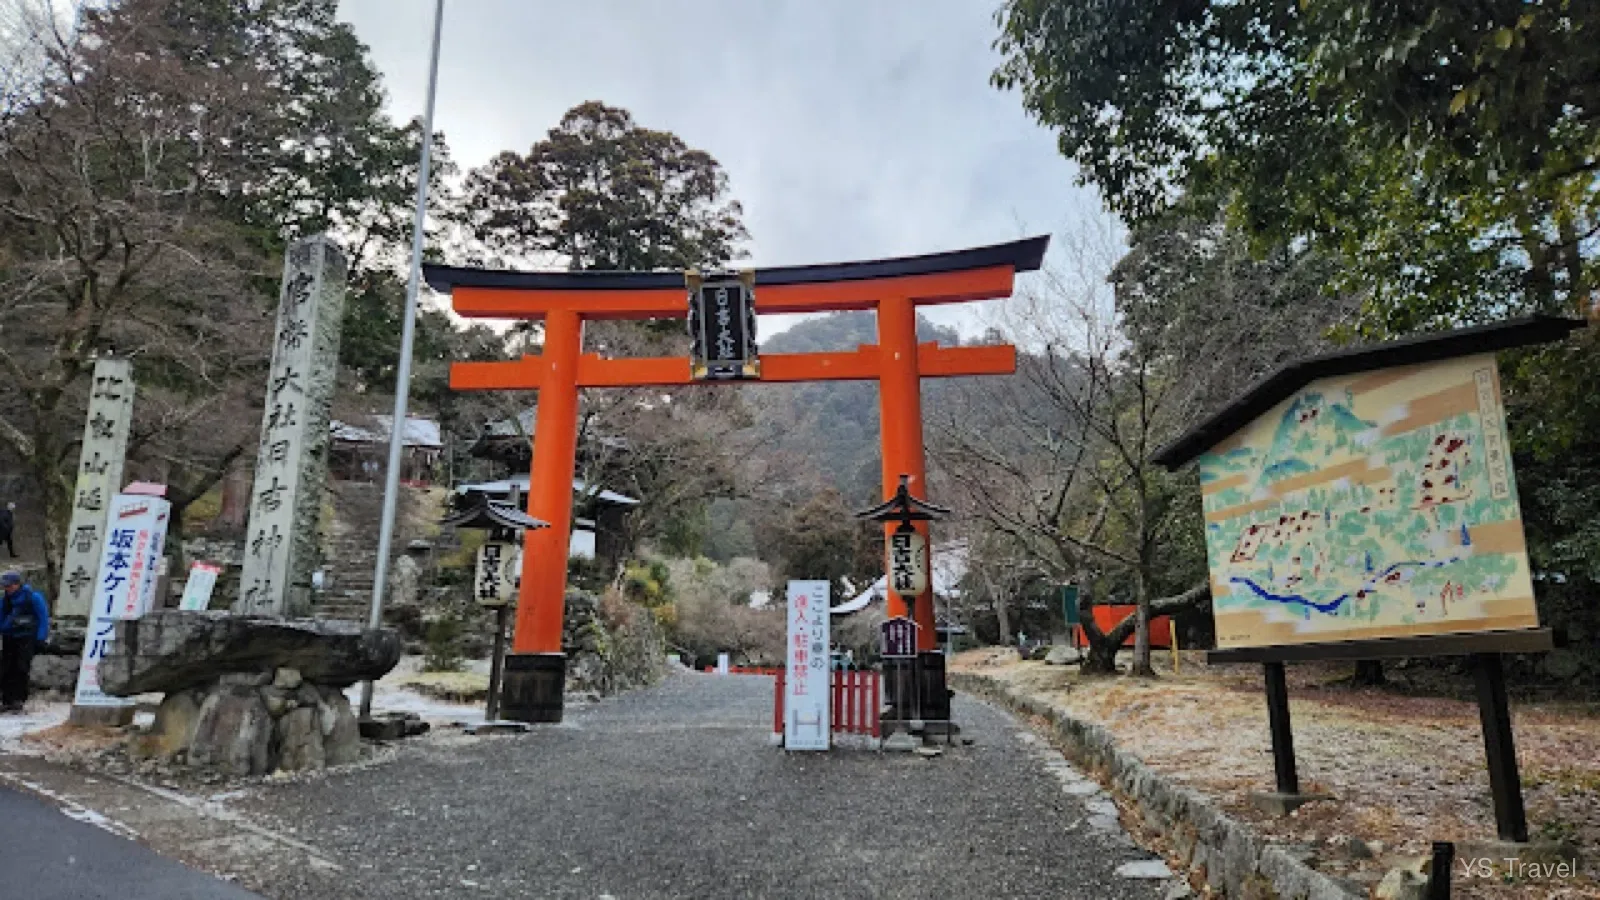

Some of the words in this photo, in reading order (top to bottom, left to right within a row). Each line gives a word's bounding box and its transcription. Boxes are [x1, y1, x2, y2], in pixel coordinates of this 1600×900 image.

[65, 375, 124, 599] 比叡山延暦寺
[479, 544, 501, 600] 日吉大社
[892, 534, 915, 590] 日吉大社
[792, 594, 809, 696] 進入・駐車禁止
[810, 585, 826, 670] ここより車の
